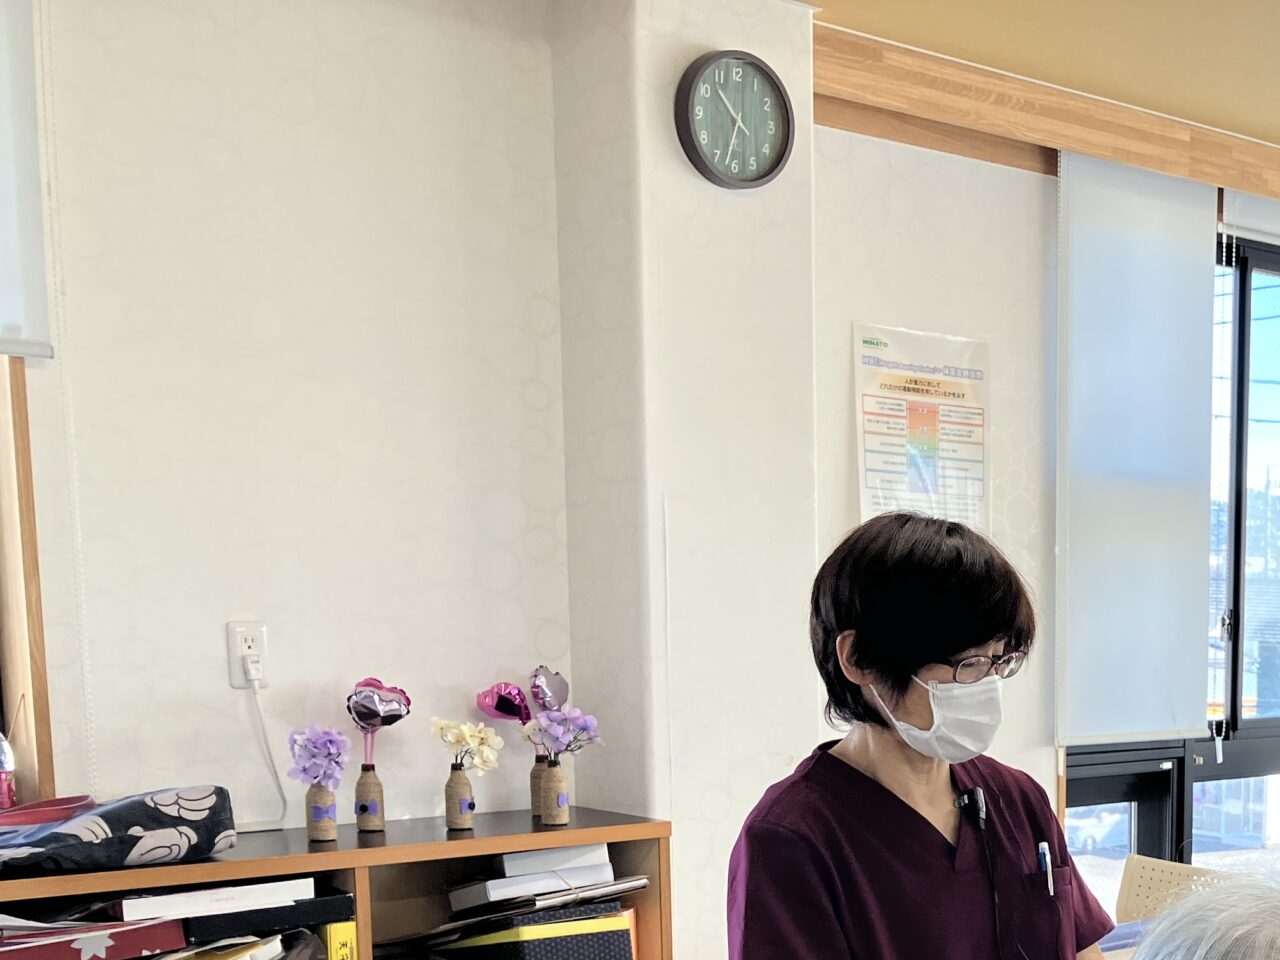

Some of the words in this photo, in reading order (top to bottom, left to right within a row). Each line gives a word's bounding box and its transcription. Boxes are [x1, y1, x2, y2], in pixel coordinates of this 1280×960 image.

[715, 69, 724, 84] 11
[732, 68, 743, 82] 12
[700, 83, 711, 98] 10
[763, 98, 771, 112] 2
[695, 107, 703, 120] 9
[767, 121, 775, 134] 3
[700, 130, 708, 144] 8
[762, 143, 770, 156] 4
[713, 150, 721, 163] 7
[731, 160, 739, 173] 6
[749, 157, 757, 170] 5
[862, 338, 888, 348] MINATO
